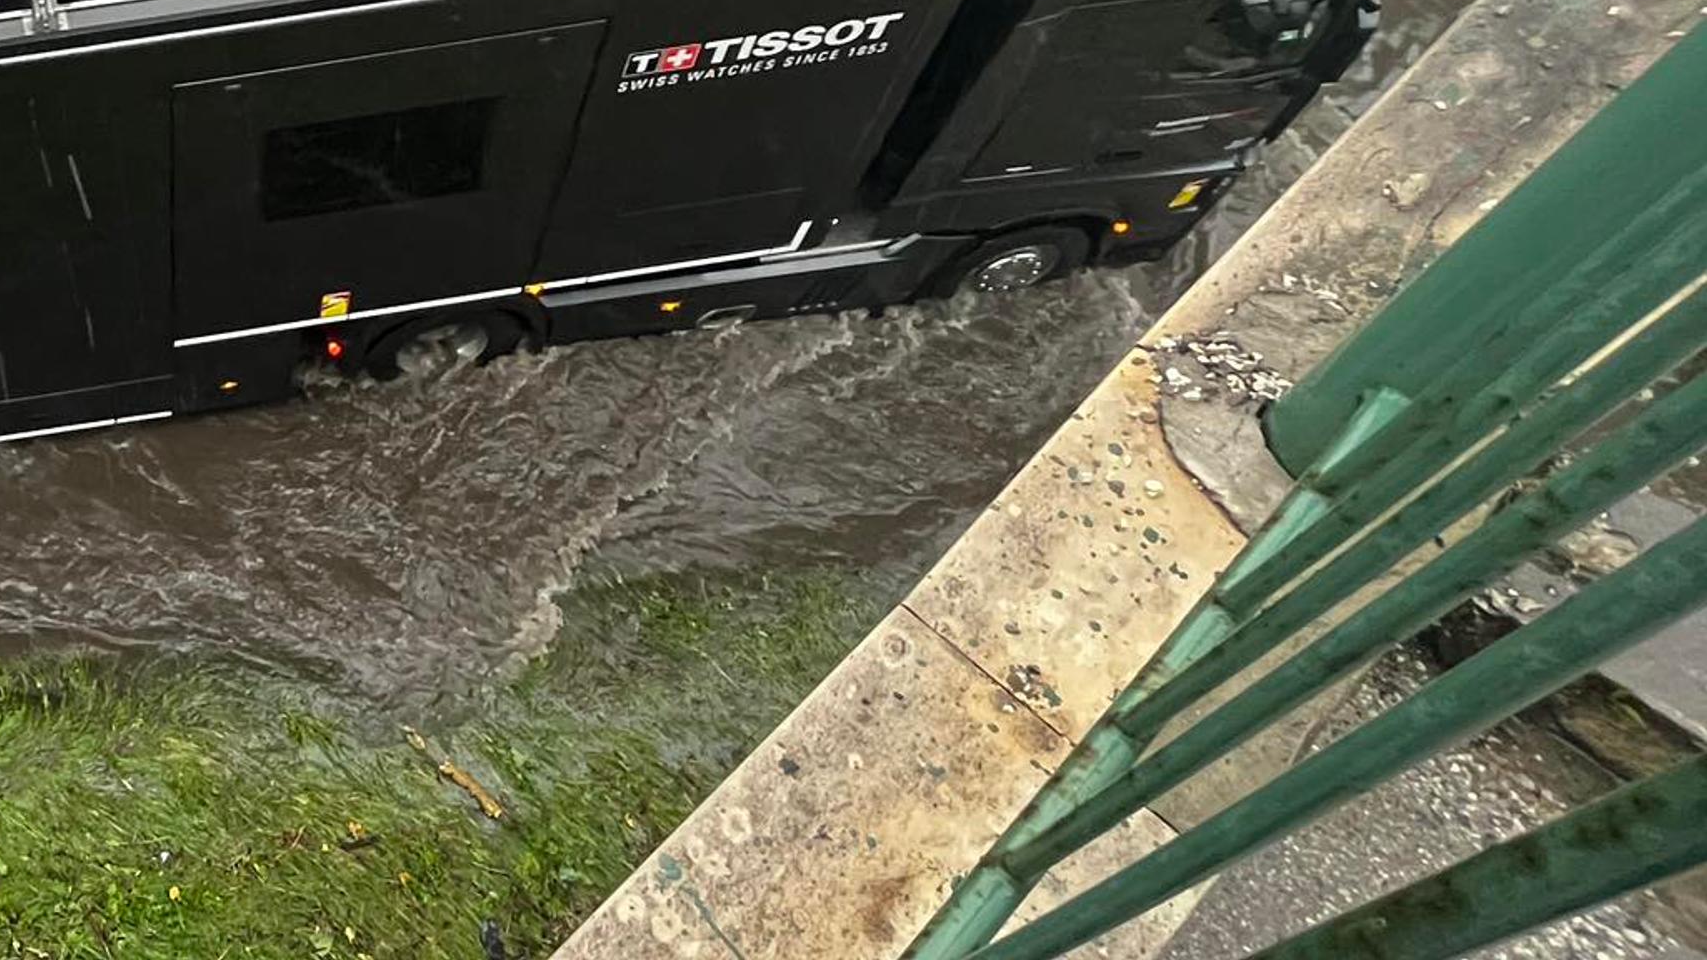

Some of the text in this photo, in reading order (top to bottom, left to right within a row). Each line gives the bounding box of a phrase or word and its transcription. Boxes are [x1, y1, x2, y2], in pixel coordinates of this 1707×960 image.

[704, 12, 905, 65] TISSOT
[616, 41, 890, 94] SWISS WATCHES SINCE 1853
